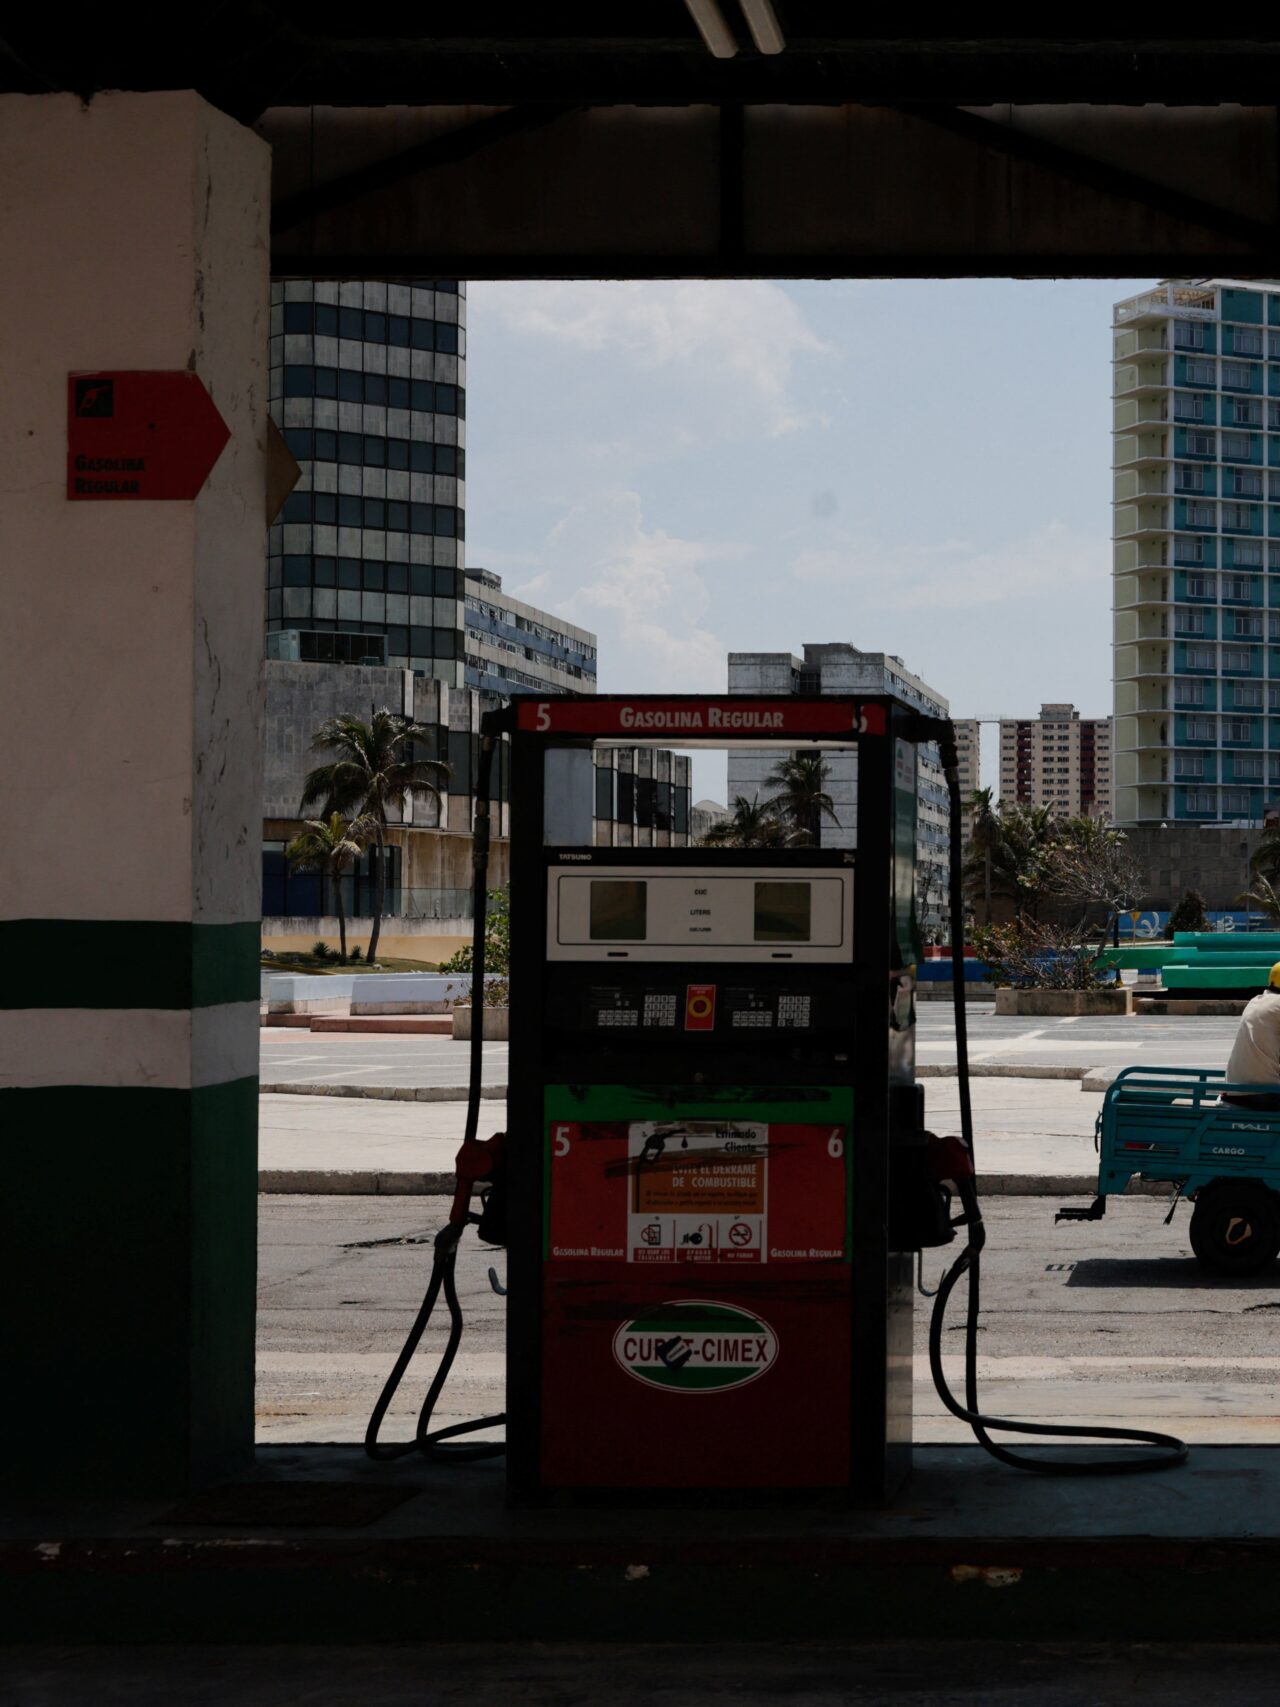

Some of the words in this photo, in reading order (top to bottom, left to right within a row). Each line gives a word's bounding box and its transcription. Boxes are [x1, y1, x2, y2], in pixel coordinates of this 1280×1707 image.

[75, 454, 145, 472] GASOLINA
[75, 477, 139, 494] REGULAR
[535, 704, 551, 732] 5
[619, 707, 702, 728] GASOLINA
[708, 707, 784, 728] REGULAR
[559, 853, 592, 861] TATSUNO
[553, 1126, 571, 1157] 5
[827, 1128, 844, 1158] 6
[1211, 1147, 1246, 1156] CARGO
[672, 1177, 685, 1187] DE
[691, 1177, 757, 1188] COMBUSTIBLE
[553, 1246, 589, 1257] GASOLINA
[590, 1246, 625, 1257] REGULAR
[771, 1248, 808, 1258] GASOLINA
[809, 1248, 842, 1258] REGULAR
[624, 1337, 768, 1362] CUP-CIMEX
